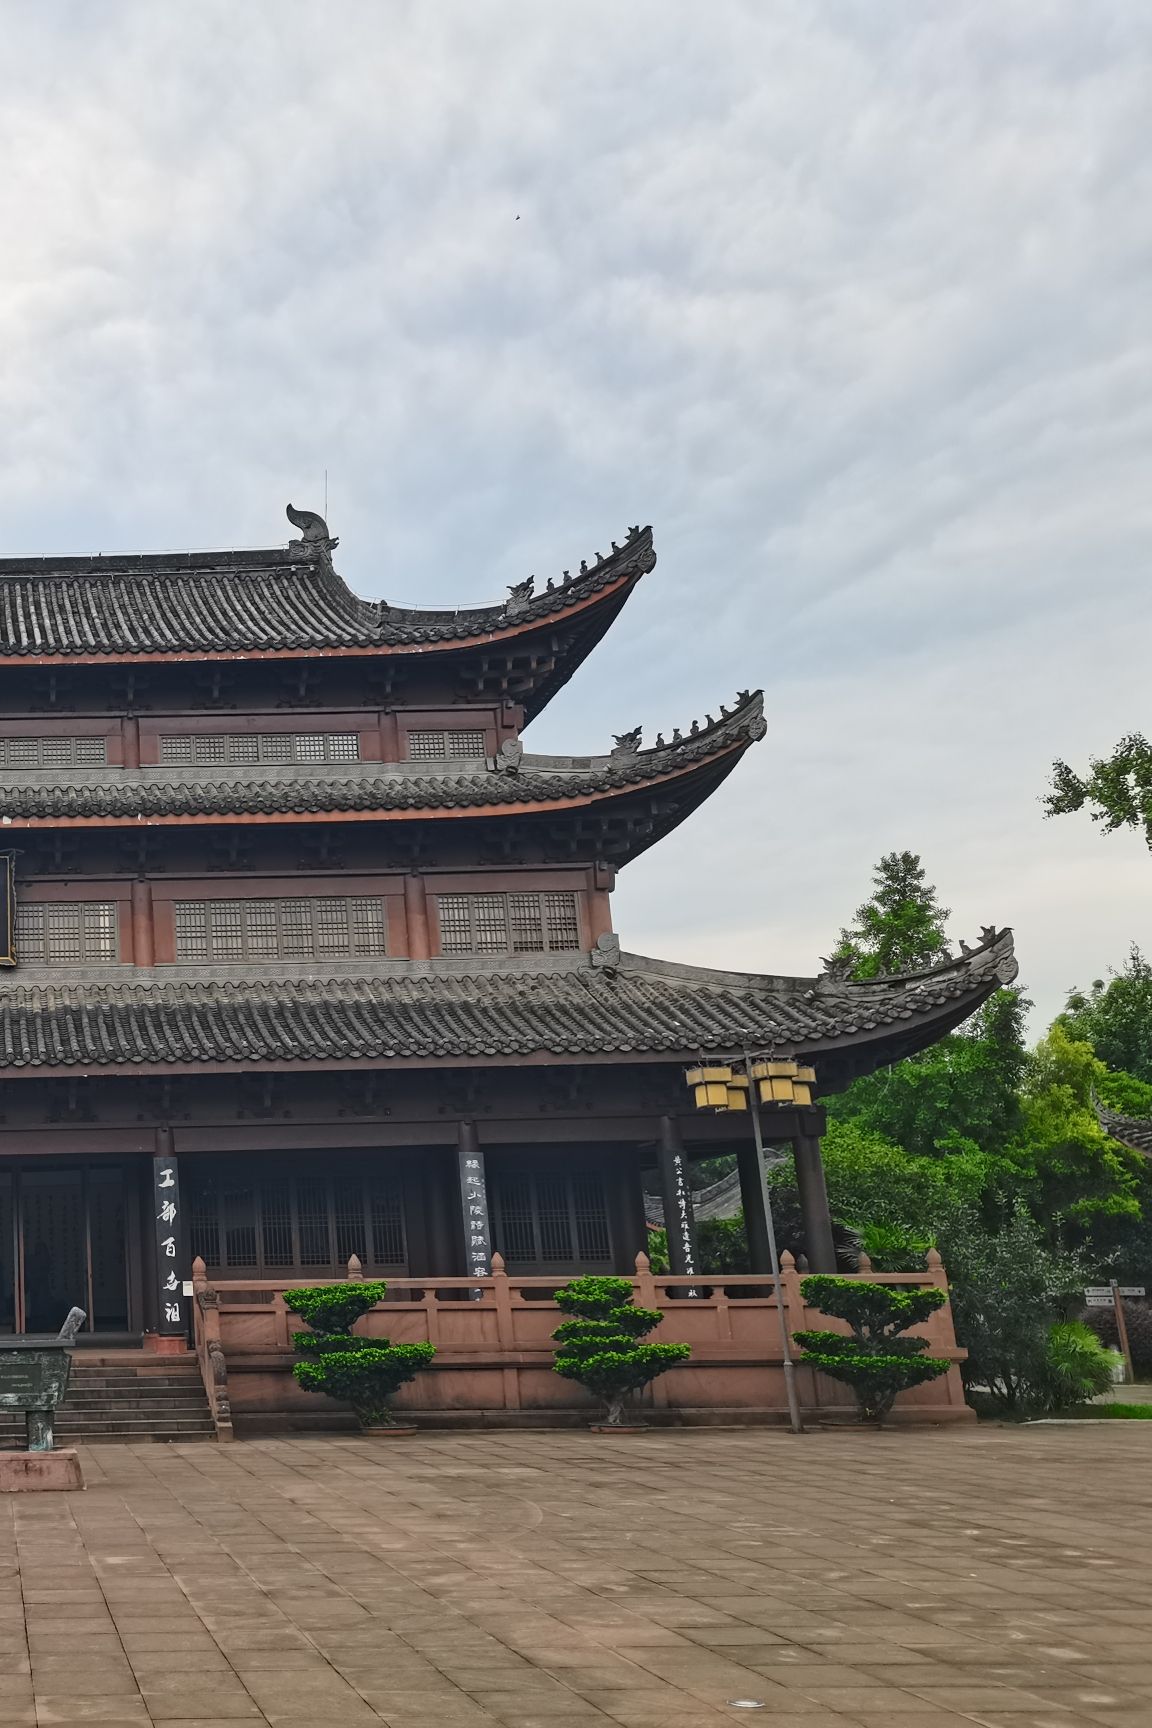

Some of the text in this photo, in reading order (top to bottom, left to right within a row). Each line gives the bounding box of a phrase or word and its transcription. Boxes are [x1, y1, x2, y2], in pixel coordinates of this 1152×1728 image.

[156, 1168, 181, 1322] 工部百世祖
[465, 1160, 488, 1301] 緣起少陵詩賦涵容
